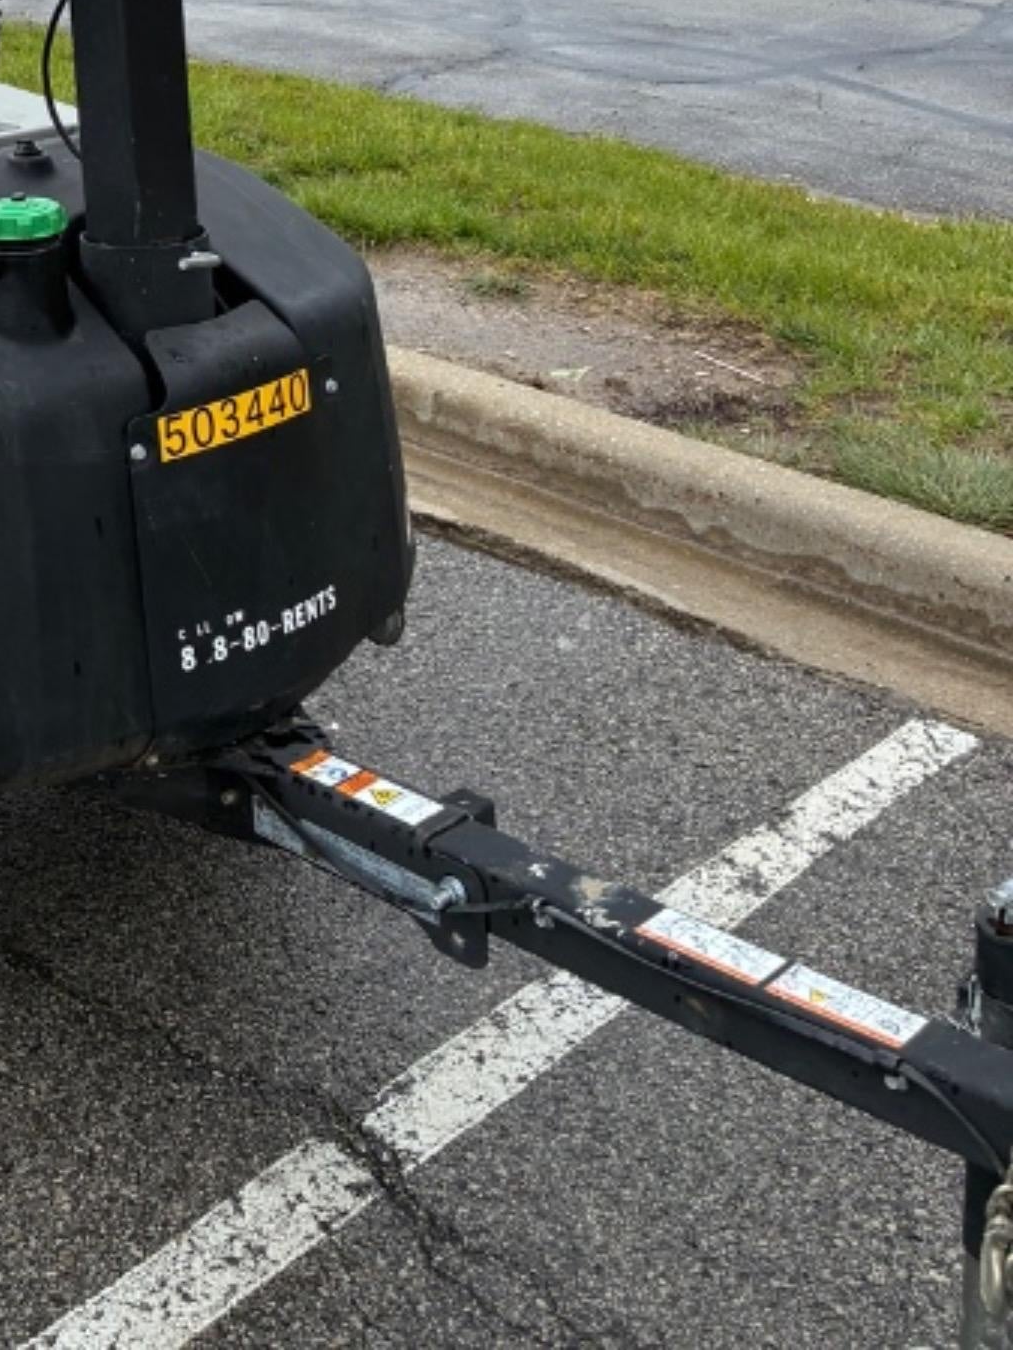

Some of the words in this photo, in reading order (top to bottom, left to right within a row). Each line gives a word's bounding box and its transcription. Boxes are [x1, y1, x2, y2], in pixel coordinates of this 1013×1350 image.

[164, 373, 306, 456] 503440
[178, 620, 211, 640] CLL
[181, 585, 337, 672] 88-80-RENTS
